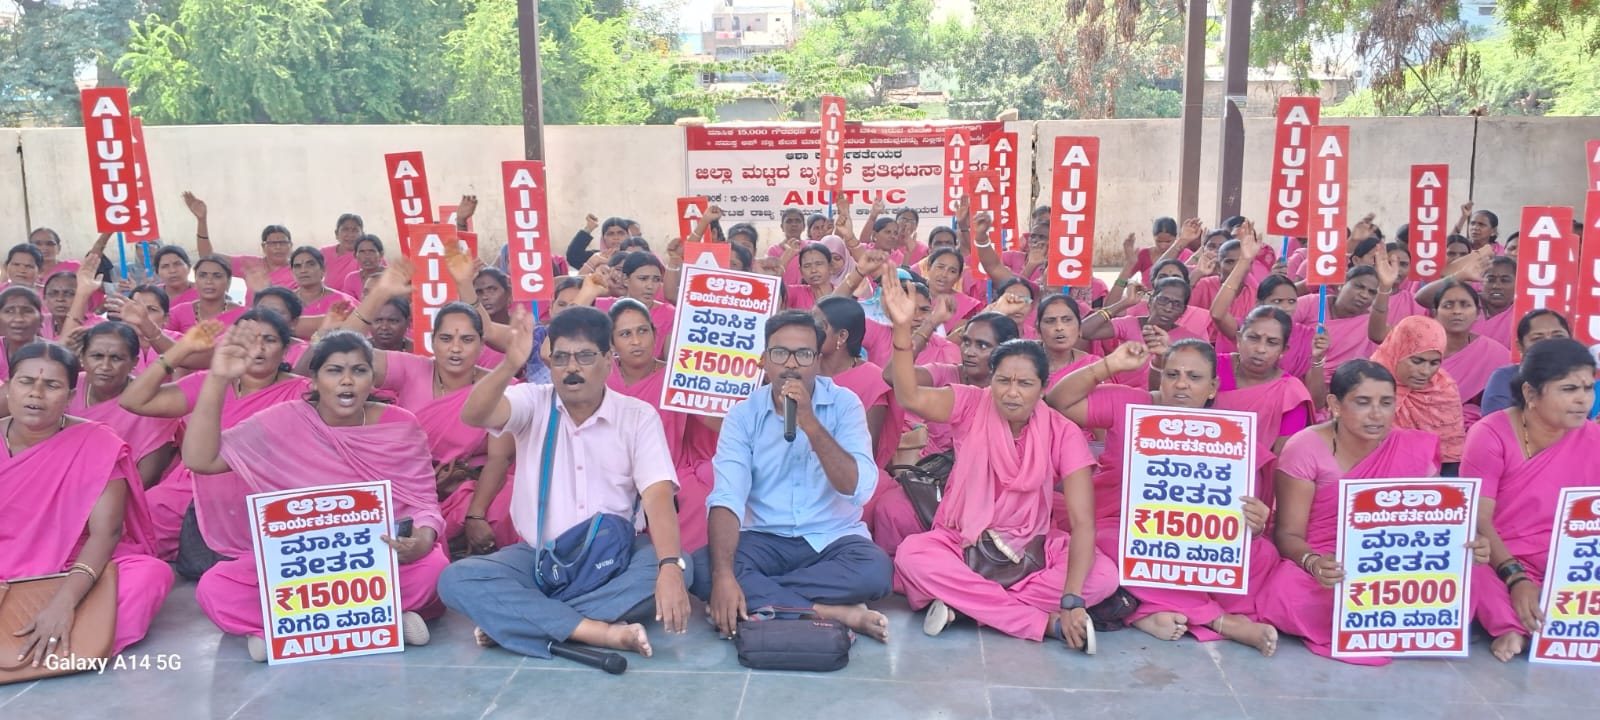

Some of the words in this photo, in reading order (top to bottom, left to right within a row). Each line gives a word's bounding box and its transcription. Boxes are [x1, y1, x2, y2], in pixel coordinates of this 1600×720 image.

[824, 102, 841, 186] AIUTUC
[91, 96, 131, 225] AIUTUC
[1276, 105, 1310, 229] AIUTUC
[783, 188, 907, 206] AIUTUC
[1315, 135, 1343, 276] AIUTUC
[1057, 145, 1091, 280] AIUTUC
[1415, 171, 1441, 277] AIUTUC
[510, 168, 545, 293] AIUTUC
[1526, 215, 1562, 311] AIUT
[706, 277, 753, 295] ಆಶಾ
[692, 309, 757, 331] ಮಾಸಿಕ
[687, 326, 755, 350] ವೇತನ
[678, 348, 758, 378] ₹15000
[672, 372, 711, 390] ನಿಗದಿ
[670, 391, 735, 412] AIUTU
[1158, 418, 1222, 438] ಆಶಾ
[1146, 457, 1232, 482] ಮಾಸಿಕ
[286, 494, 356, 515] ಆಶಾ
[1142, 480, 1232, 506] ವೇತನ
[1374, 489, 1442, 507] ಆಶಾ
[1134, 508, 1240, 541] ₹15000
[280, 527, 372, 556] ಮಾಸಿಕ
[1130, 538, 1181, 560] ನಿಗದಿ
[1186, 543, 1241, 564] ಮಾಡಿ!
[1361, 528, 1451, 549] ಮಾಸಿಕ
[280, 548, 375, 579] ವೇತನ
[1130, 561, 1236, 585] AIUTUC
[1357, 550, 1450, 573] ವೇತನ
[275, 575, 387, 612] ₹15000
[1349, 578, 1457, 607] ₹15000
[277, 612, 330, 635] ನಿಗದಿ
[336, 605, 393, 628] ಮಾಡಿ!
[1345, 610, 1397, 628] ನಿಗದಿ
[1402, 609, 1459, 627] ಮಾಡಿ!
[281, 628, 391, 657] AIUTUC
[1345, 631, 1456, 650] AIUTUC
